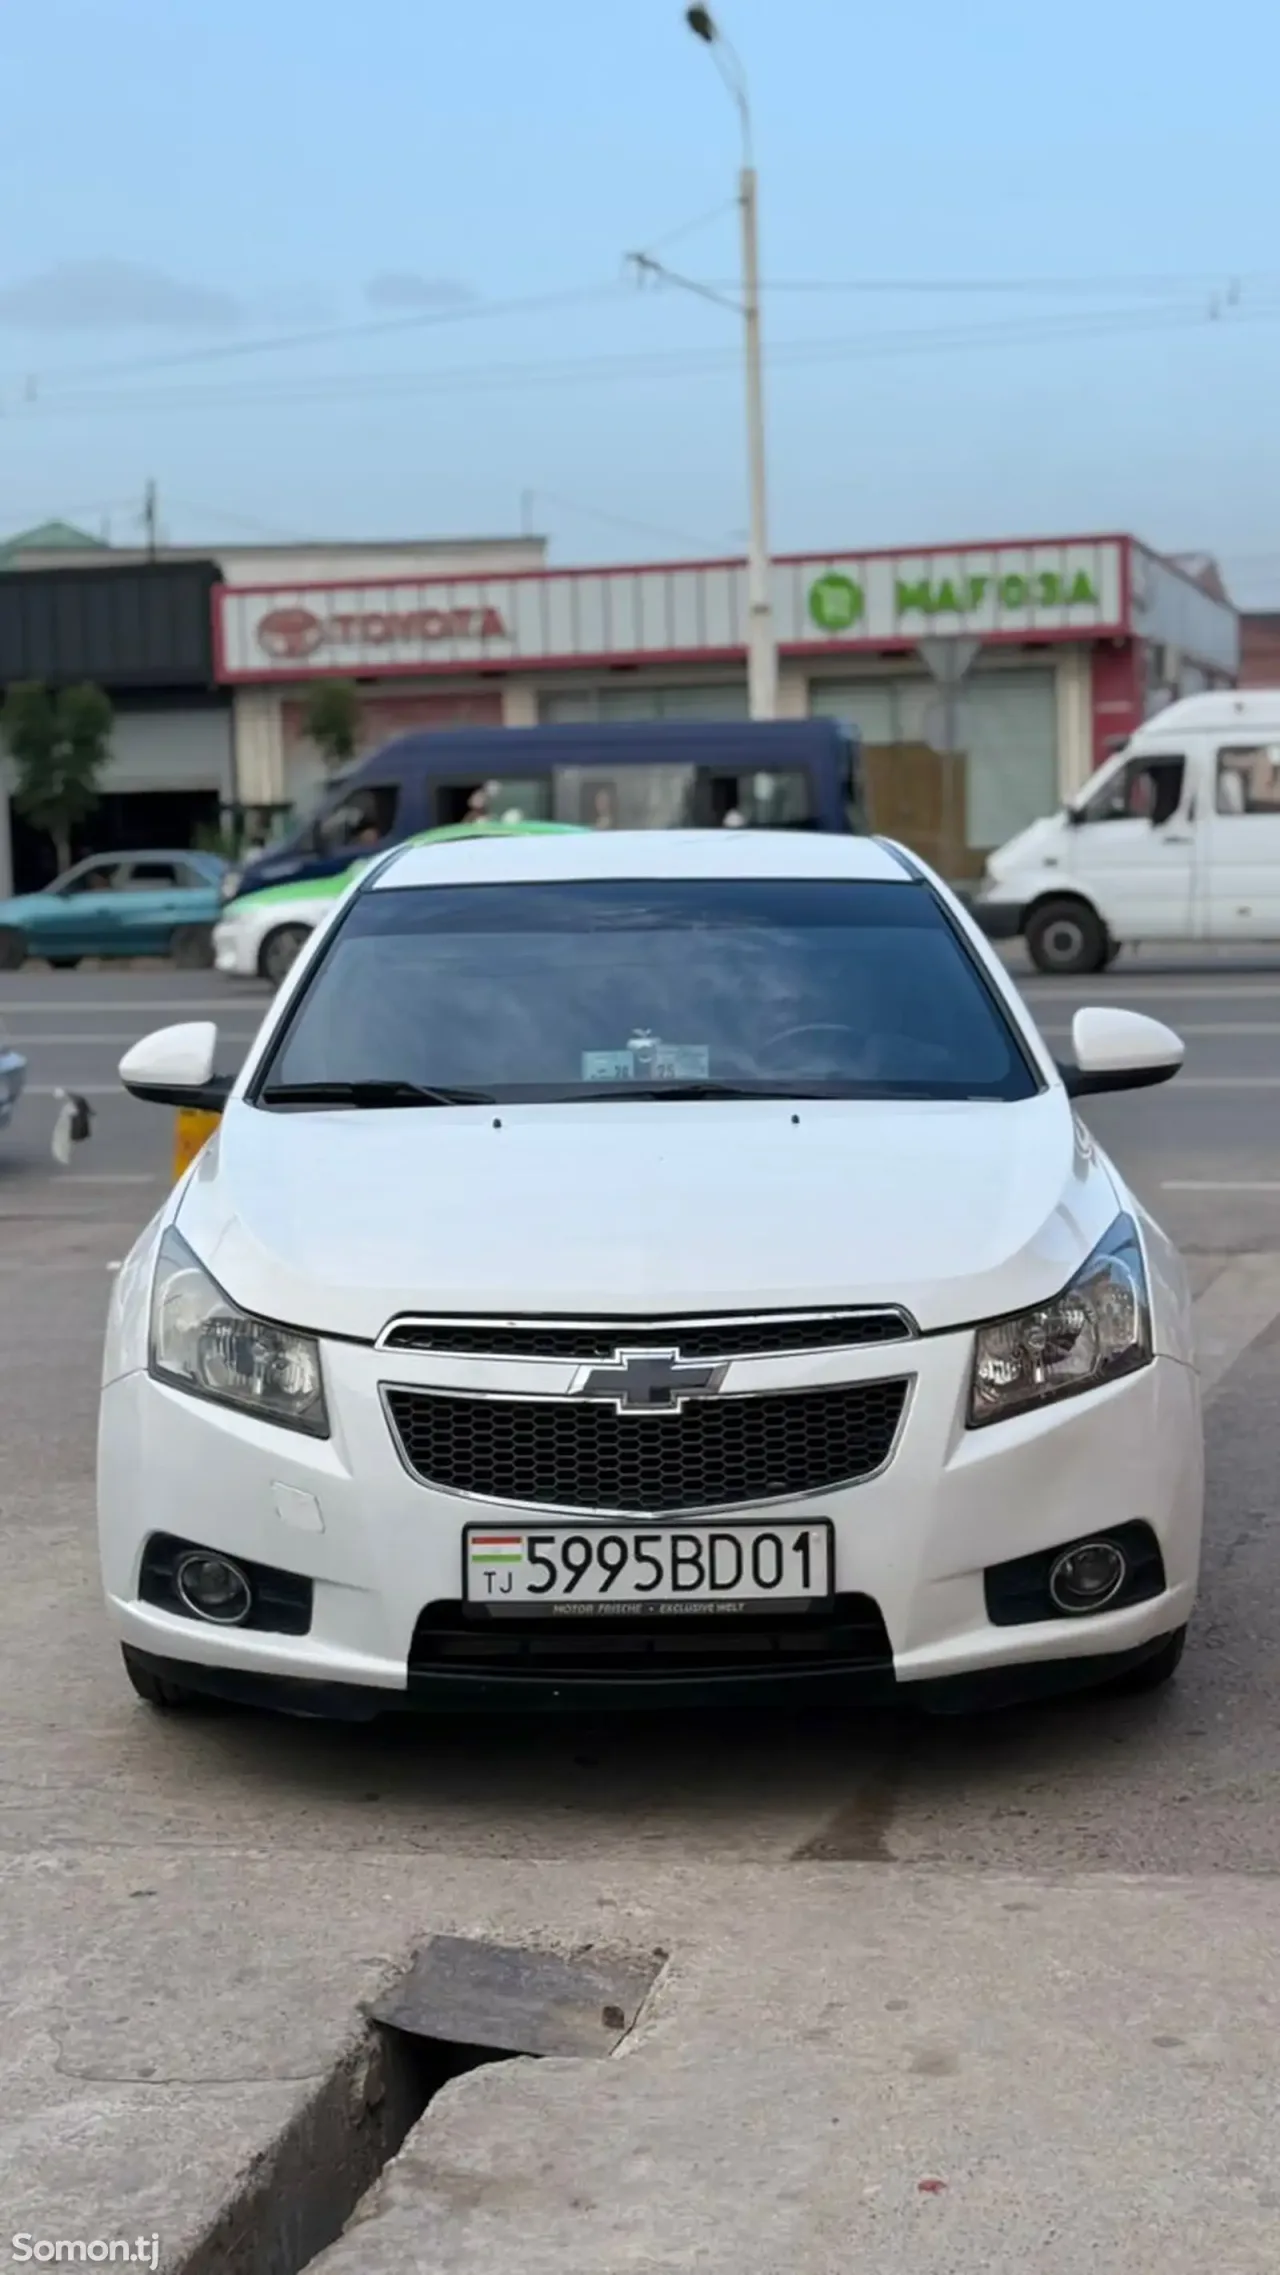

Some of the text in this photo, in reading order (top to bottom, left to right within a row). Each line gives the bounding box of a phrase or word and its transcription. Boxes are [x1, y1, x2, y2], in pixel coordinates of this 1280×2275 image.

[328, 608, 507, 645] TOYOTA
[526, 1531, 811, 1594] 5995BD01
[483, 1570, 513, 1594] TJ
[552, 1602, 594, 1615] MOTOR
[659, 1602, 714, 1615] EXCLUSIVE
